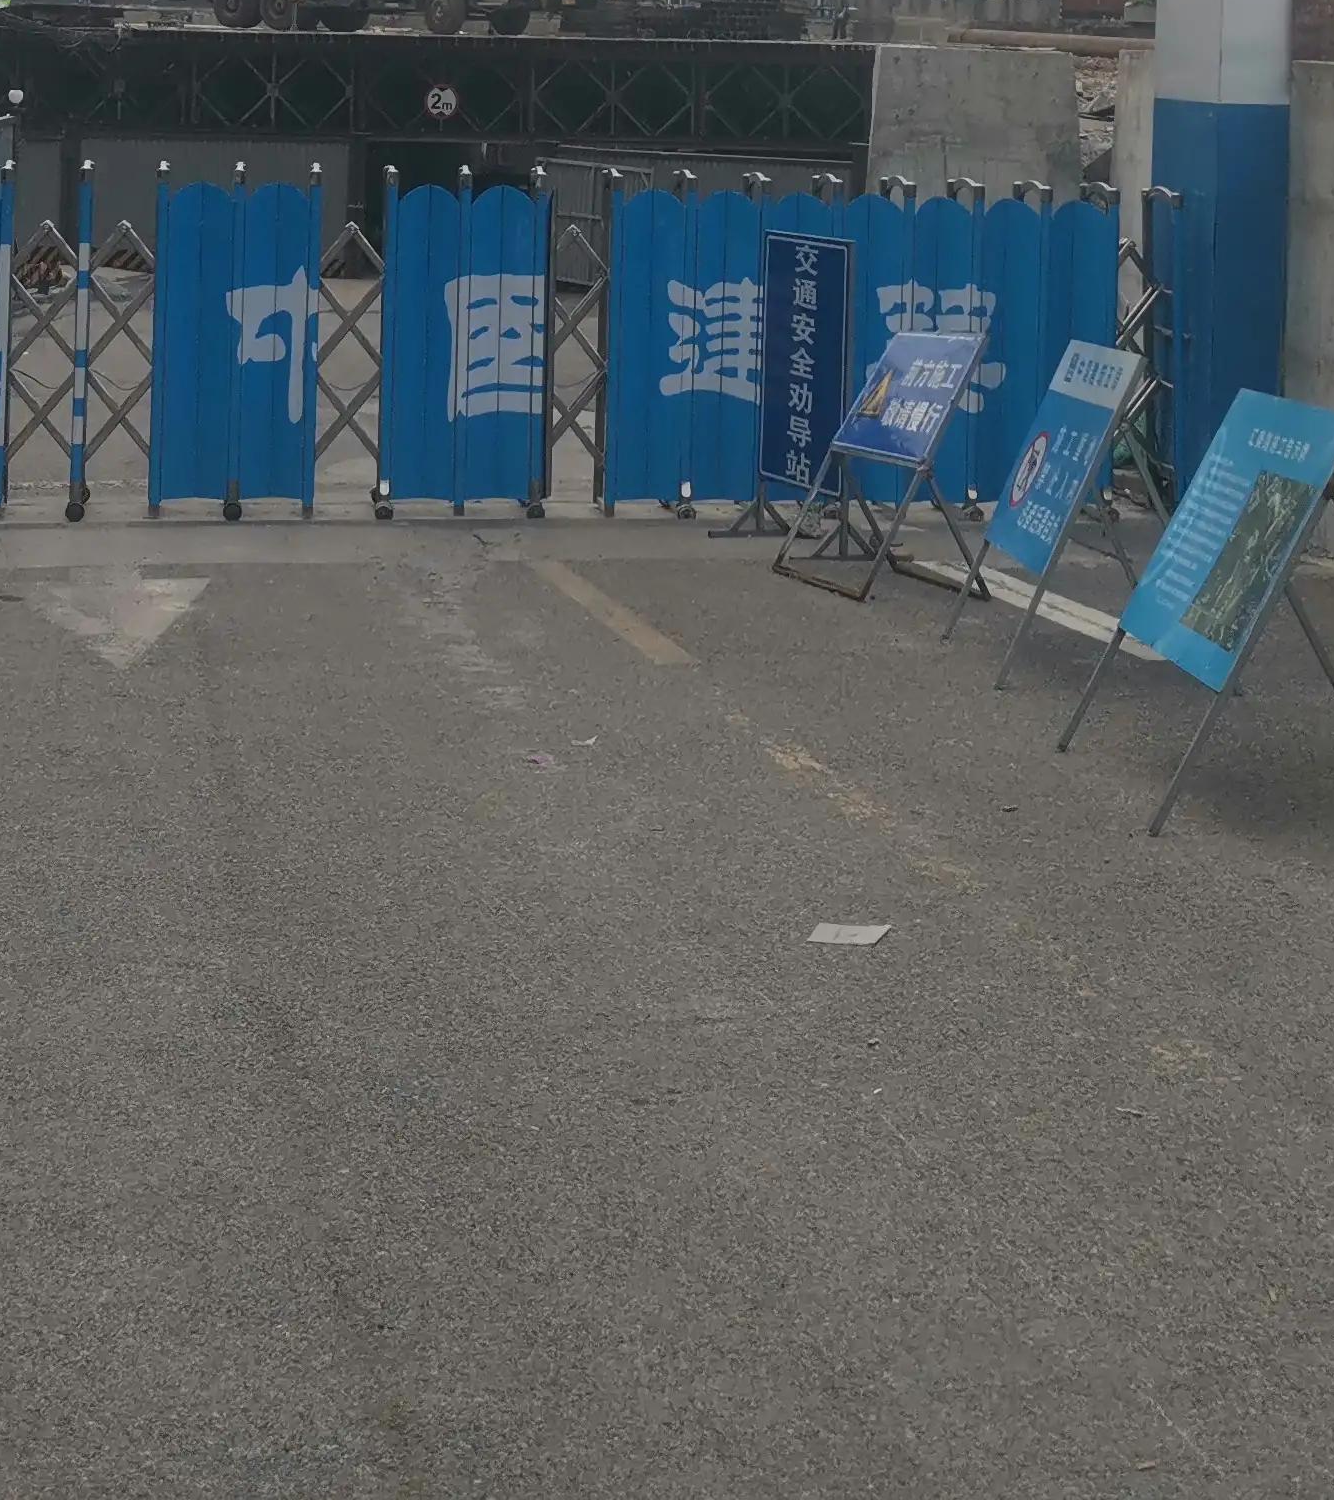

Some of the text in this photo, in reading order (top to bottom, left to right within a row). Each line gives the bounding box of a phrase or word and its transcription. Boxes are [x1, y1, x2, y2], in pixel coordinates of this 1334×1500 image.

[430, 92, 453, 111] 2m
[785, 243, 820, 488] 交通安全劝导站
[900, 358, 964, 389] 前方施工
[880, 396, 945, 434] 敬请慢行
